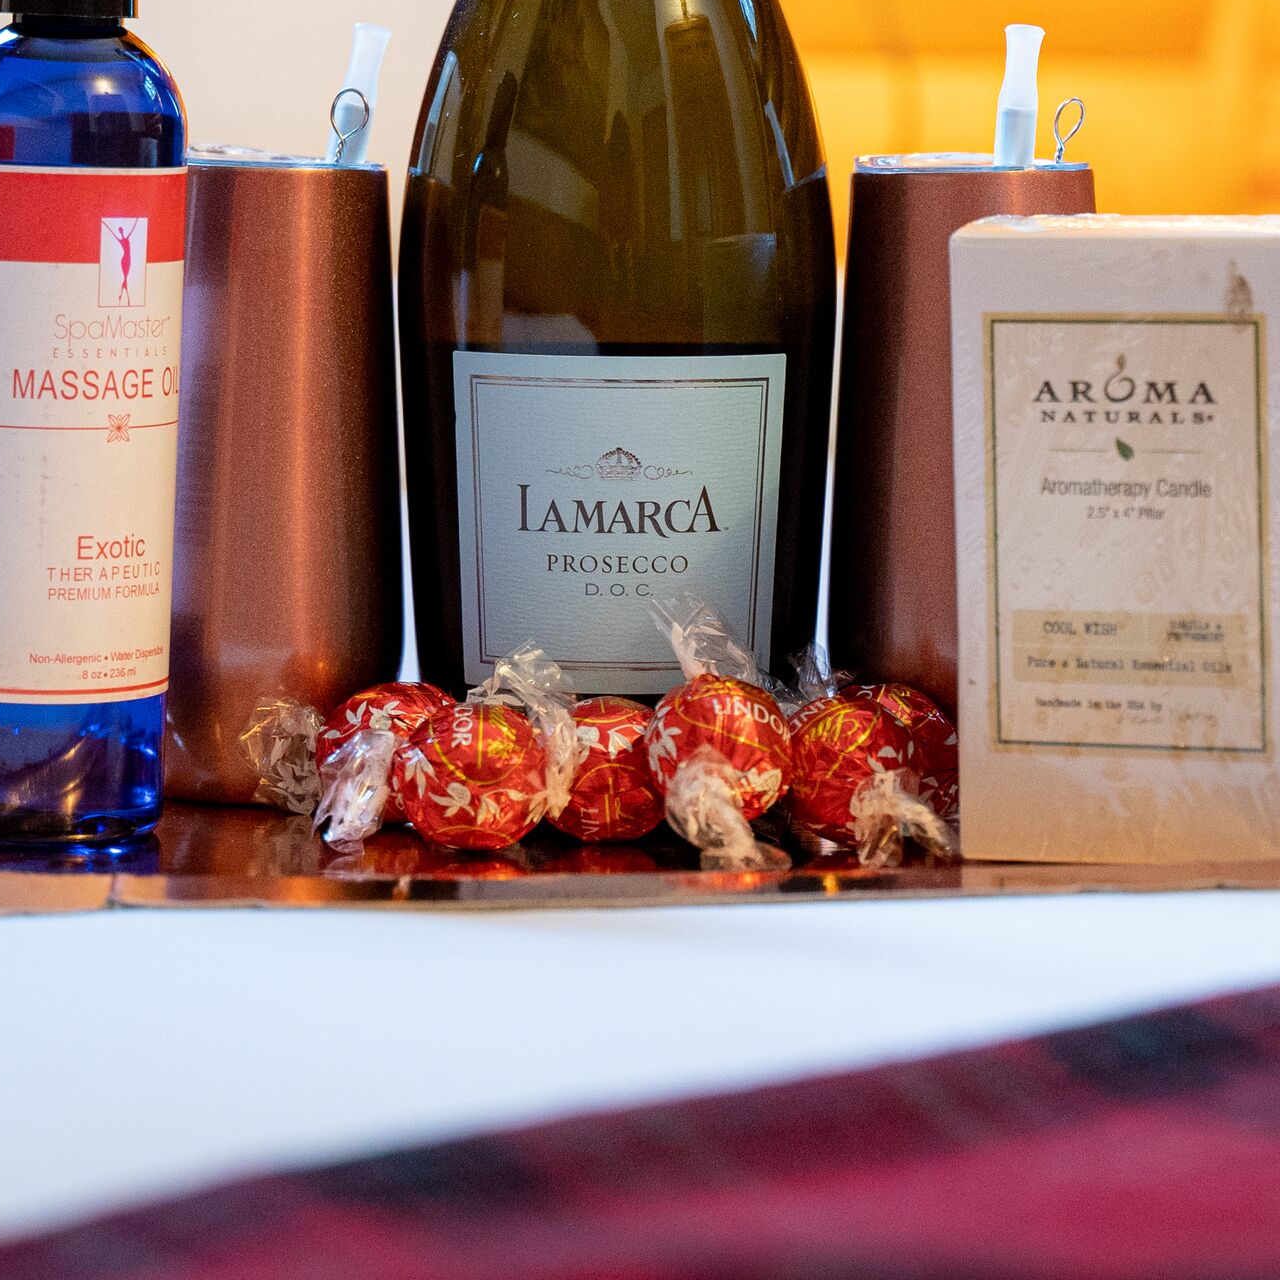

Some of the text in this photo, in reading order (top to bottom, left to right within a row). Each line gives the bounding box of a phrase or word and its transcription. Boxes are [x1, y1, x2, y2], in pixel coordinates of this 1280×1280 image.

[54, 313, 167, 348] SpaMaster
[53, 345, 168, 359] ESSENTIALS
[12, 365, 179, 400] MASSAGE OIL
[1033, 370, 1218, 405] AROMA
[1040, 477, 1213, 498] Aromatherapy Candle
[77, 533, 146, 560] Exotic
[46, 561, 161, 582] THERAPEUTIC
[546, 554, 689, 574] PROSECCO
[48, 582, 161, 601] PREMIUM FORMULA
[29, 653, 102, 665] Non-Allergenic
[110, 650, 133, 662] Water
